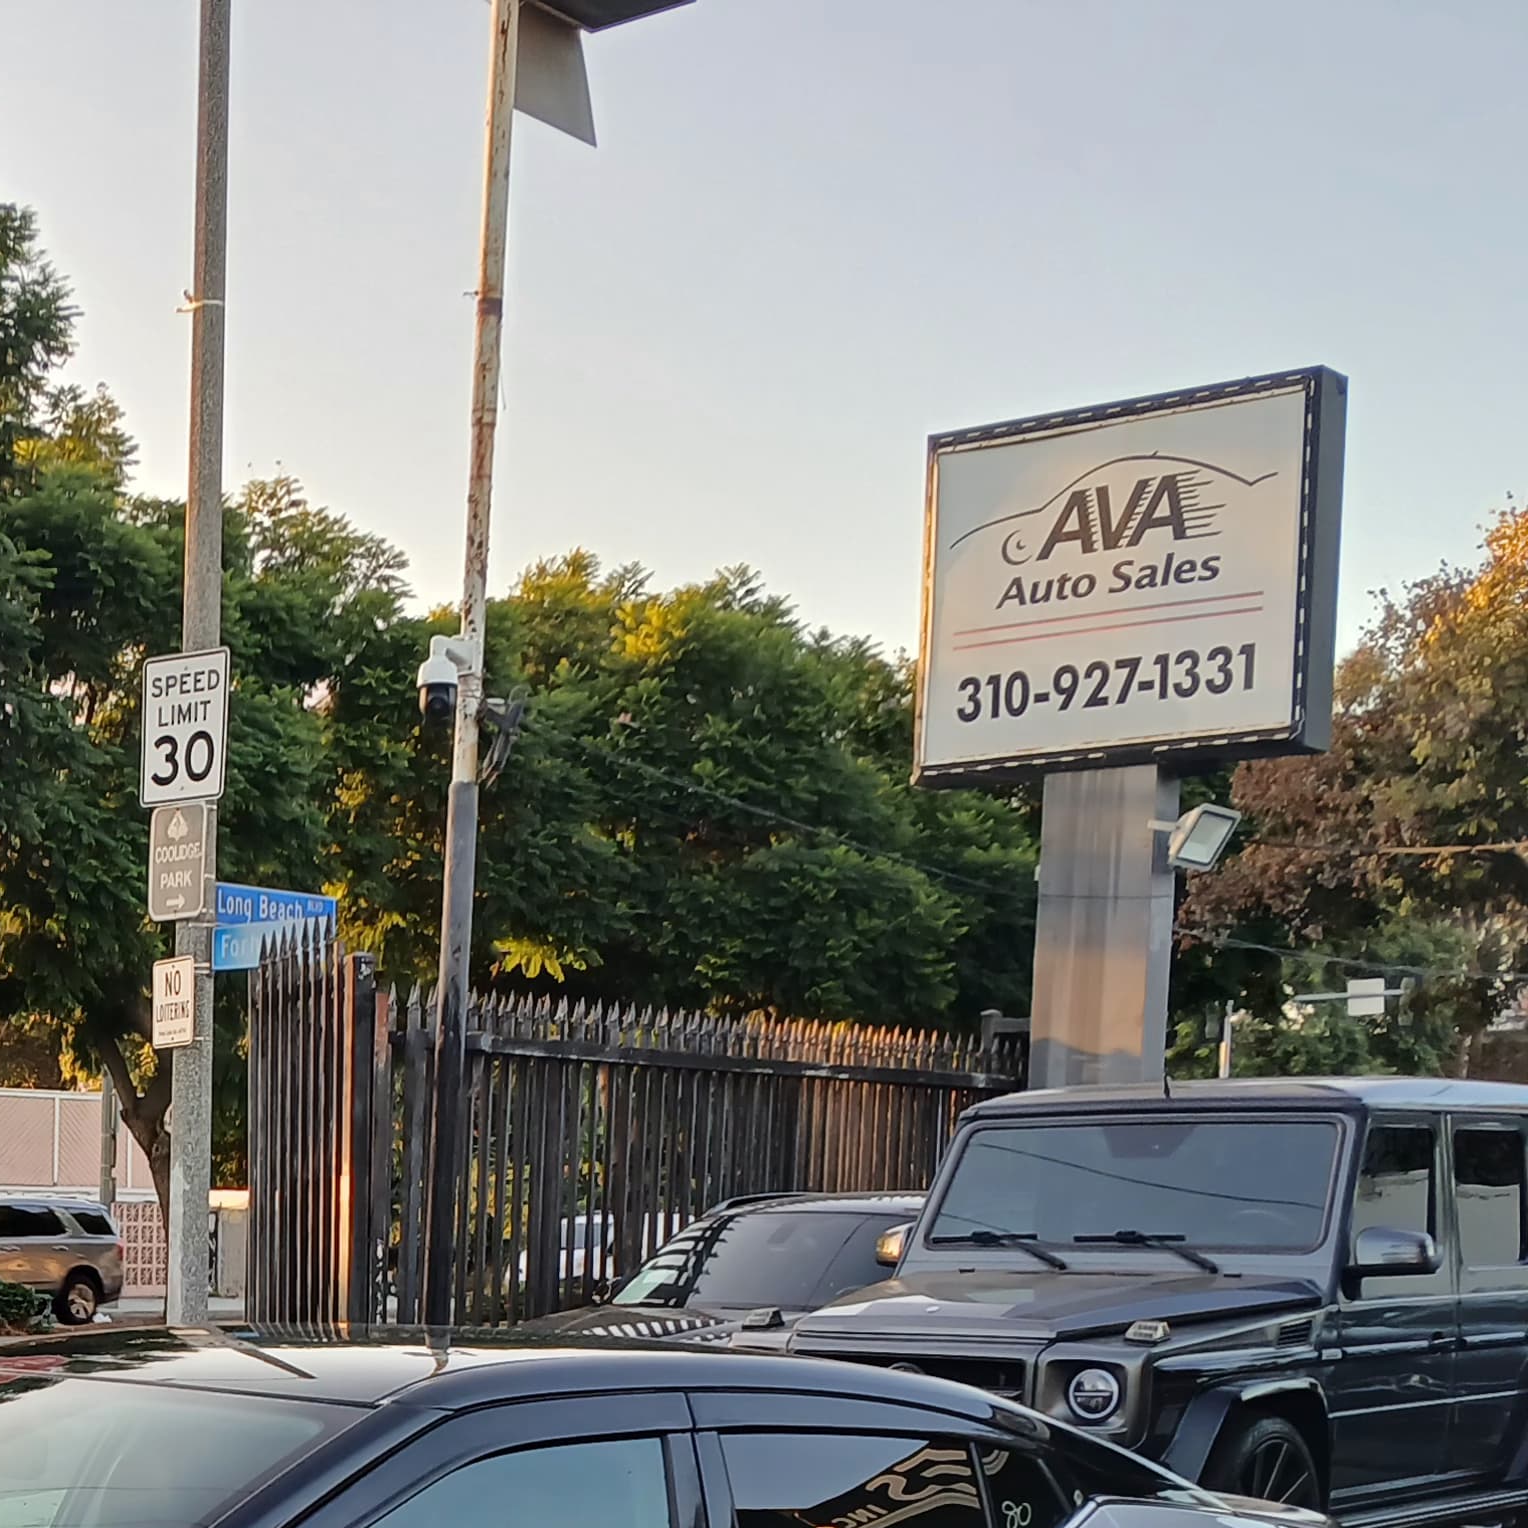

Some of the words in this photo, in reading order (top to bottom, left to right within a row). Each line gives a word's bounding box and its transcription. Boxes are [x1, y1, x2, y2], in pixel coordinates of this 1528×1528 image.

[1036, 470, 1226, 561] AVA
[995, 574, 1097, 610] Auto
[1108, 552, 1221, 594] Sales
[152, 669, 220, 698] SPEED
[956, 643, 1256, 723] 310-927-1331
[158, 700, 211, 727] LIMIT
[151, 730, 215, 786] 30
[155, 841, 201, 865] COOLIDGE
[160, 870, 193, 889] PARK
[218, 888, 253, 923] Long
[259, 895, 303, 921] Beach
[165, 970, 182, 997] NO
[156, 1000, 190, 1023] LOITERING
